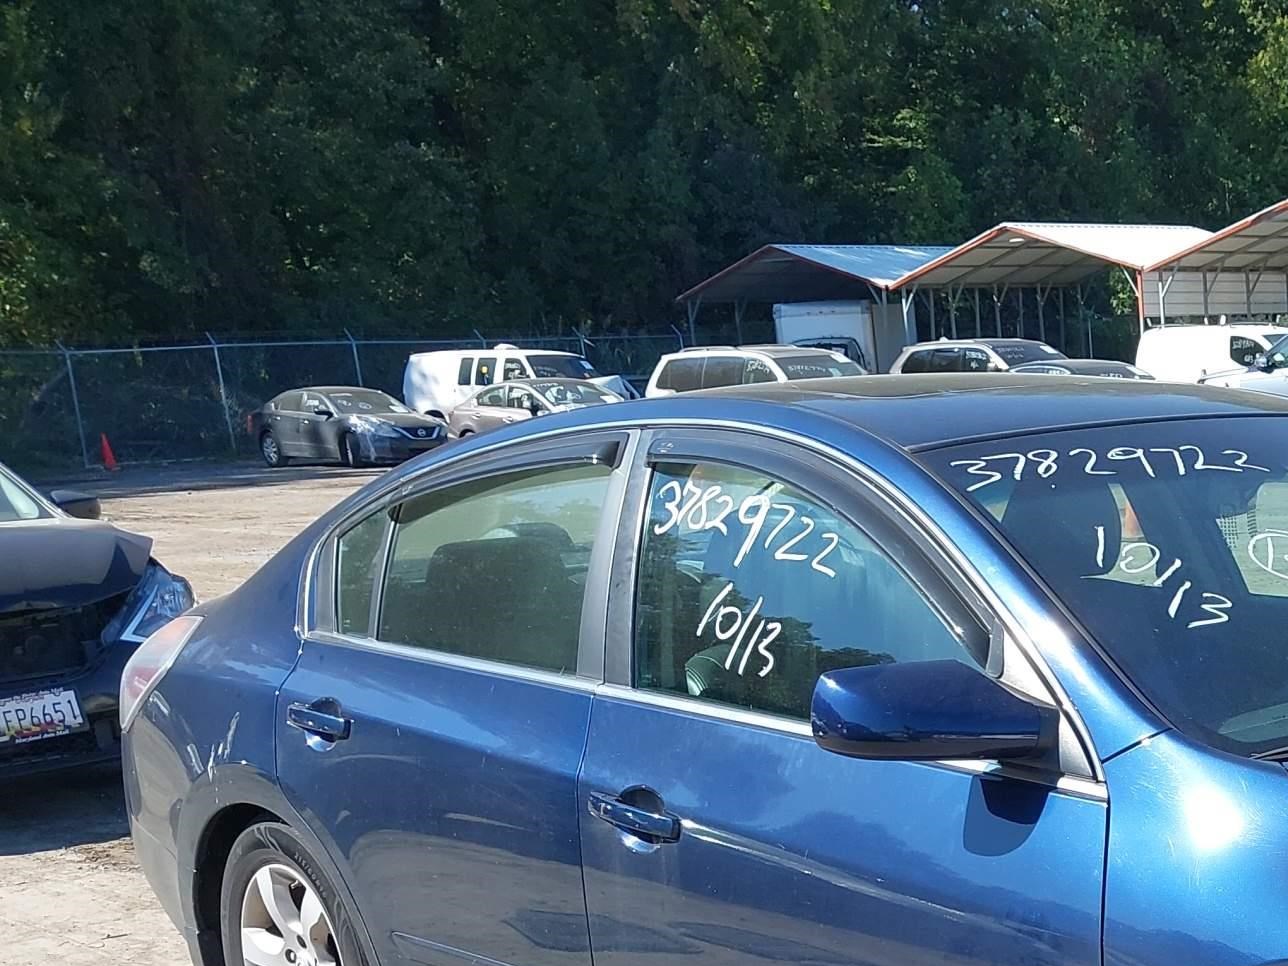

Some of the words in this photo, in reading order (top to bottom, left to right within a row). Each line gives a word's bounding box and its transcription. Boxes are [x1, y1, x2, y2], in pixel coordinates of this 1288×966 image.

[950, 445, 1270, 492] 37829722
[654, 480, 839, 578] 37829722
[1094, 525, 1233, 628] 10/13
[697, 582, 782, 677] 10/13
[2, 699, 77, 732] FP6651
